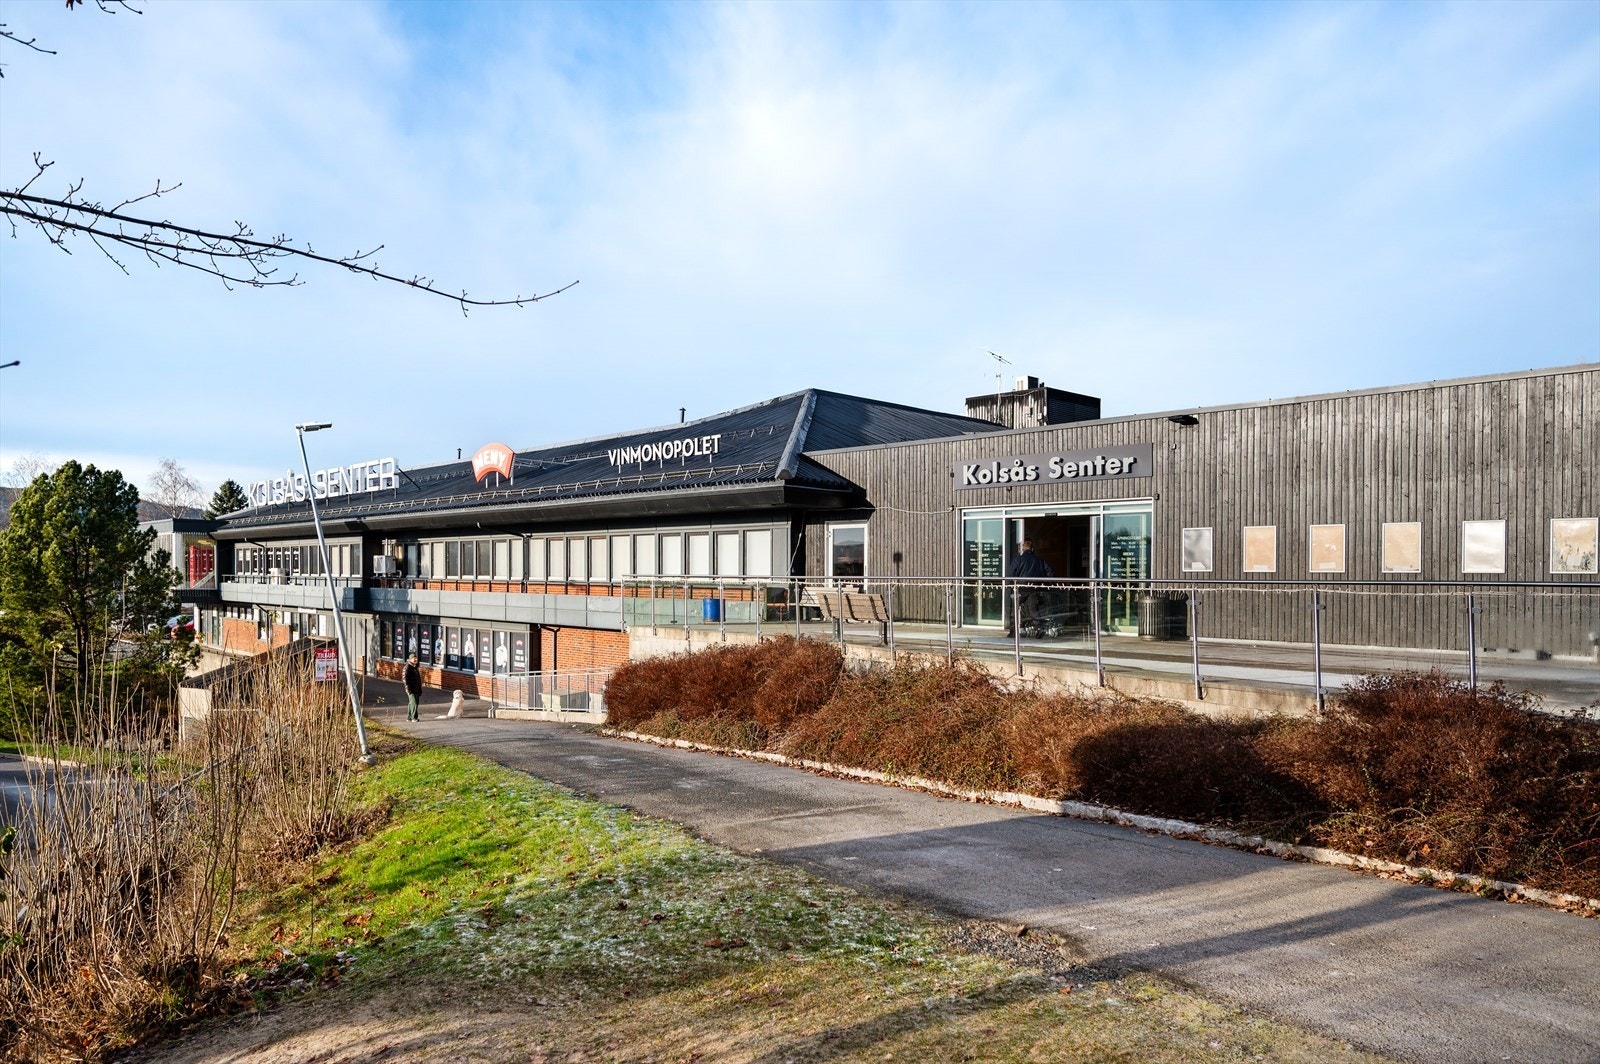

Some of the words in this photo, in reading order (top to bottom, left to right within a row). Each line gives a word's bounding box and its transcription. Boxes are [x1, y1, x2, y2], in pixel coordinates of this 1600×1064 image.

[473, 449, 507, 475] MENY
[608, 434, 722, 467] VINMONOPOLET
[248, 469, 309, 508] KOLSÅS
[314, 457, 399, 499] SENTER
[962, 459, 1039, 486] Kolsås
[1048, 455, 1137, 480] Senter
